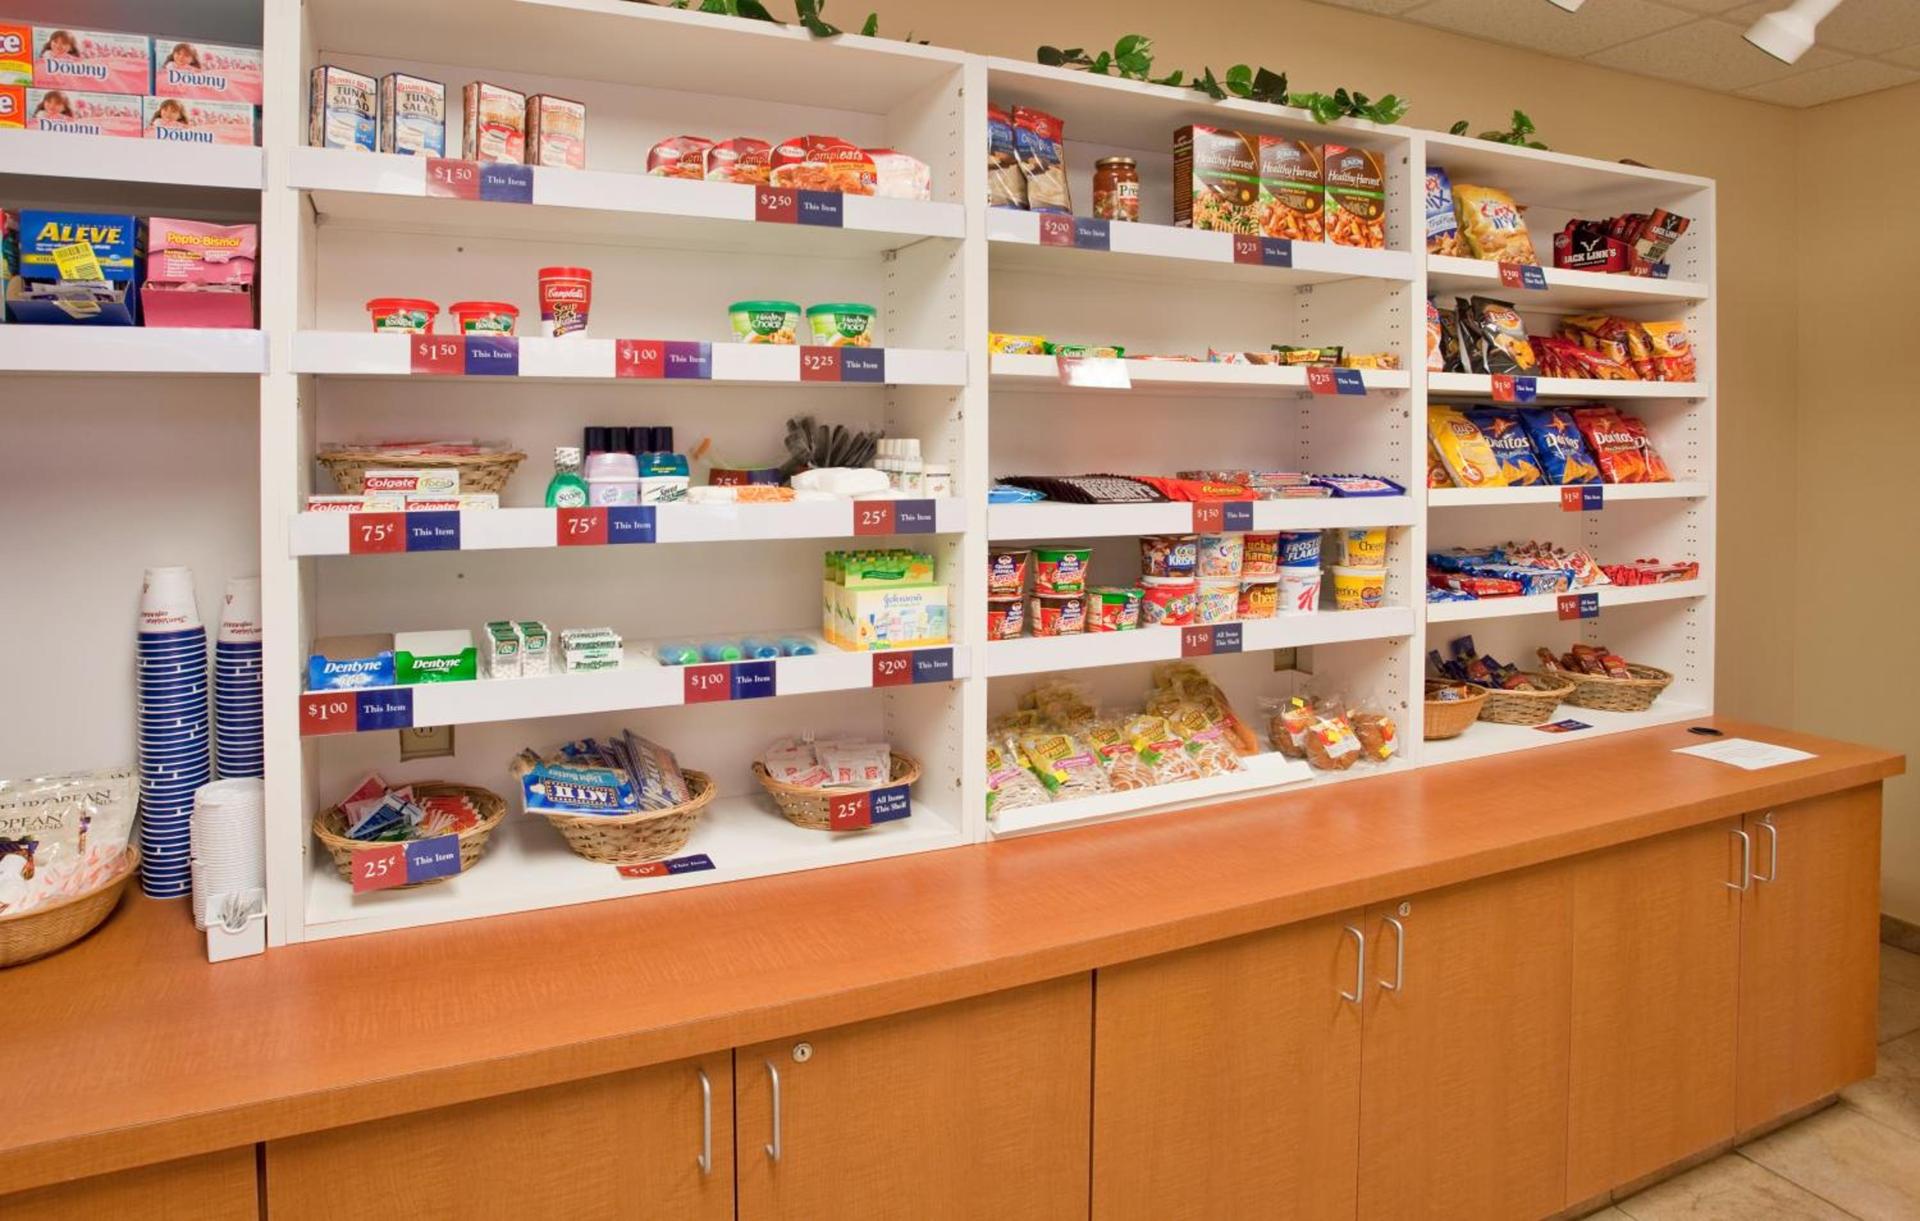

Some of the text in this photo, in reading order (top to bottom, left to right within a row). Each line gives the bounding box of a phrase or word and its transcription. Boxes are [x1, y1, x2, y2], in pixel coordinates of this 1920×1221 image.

[47, 58, 106, 79] Downy
[169, 70, 225, 90] Downy
[337, 86, 367, 101] TUNA
[406, 93, 435, 106] TUNA
[333, 96, 370, 112] SALAD
[402, 103, 439, 117] SALAD
[157, 127, 213, 143] Downy
[805, 149, 863, 163] Compleats
[1227, 155, 1254, 170] Harvest
[1262, 161, 1319, 179] Healthy Harvest
[487, 176, 505, 184] This
[508, 176, 527, 186] Item
[1328, 170, 1381, 187] Healthy Harvest
[804, 202, 819, 211] This
[821, 203, 837, 212] Item
[37, 222, 122, 244] ALEVE
[167, 231, 240, 247] Pepto-Bismol
[1564, 248, 1617, 263] JACK LINK'S
[548, 287, 583, 299] Campbell's
[752, 320, 781, 329] Choice
[756, 313, 783, 323] Healthy
[842, 315, 868, 325] Healthy
[837, 322, 865, 330] Choice
[472, 350, 490, 358] This
[493, 350, 512, 358] Item
[670, 355, 686, 363] This
[689, 355, 706, 363] Item
[846, 361, 861, 369] This
[863, 361, 878, 369] Item
[1486, 432, 1530, 449] Doritos
[1593, 429, 1633, 444] Doritos
[367, 478, 415, 489] Colgate
[901, 513, 915, 521] This
[917, 513, 931, 521] Item
[361, 523, 454, 541] 75¢ This Item
[568, 517, 651, 534] 75¢ This Item
[324, 660, 382, 674] Dentyne
[412, 658, 461, 669] Dentyne
[918, 661, 932, 670] This
[934, 660, 948, 668] Item
[735, 675, 751, 684] This
[753, 674, 770, 683] Item
[363, 705, 384, 714] This
[386, 703, 406, 712] Item
[554, 785, 609, 802] ACT II
[838, 800, 863, 818] 25¢
[875, 802, 907, 813] This Shelf
[364, 852, 454, 878] 25¢ This Item
